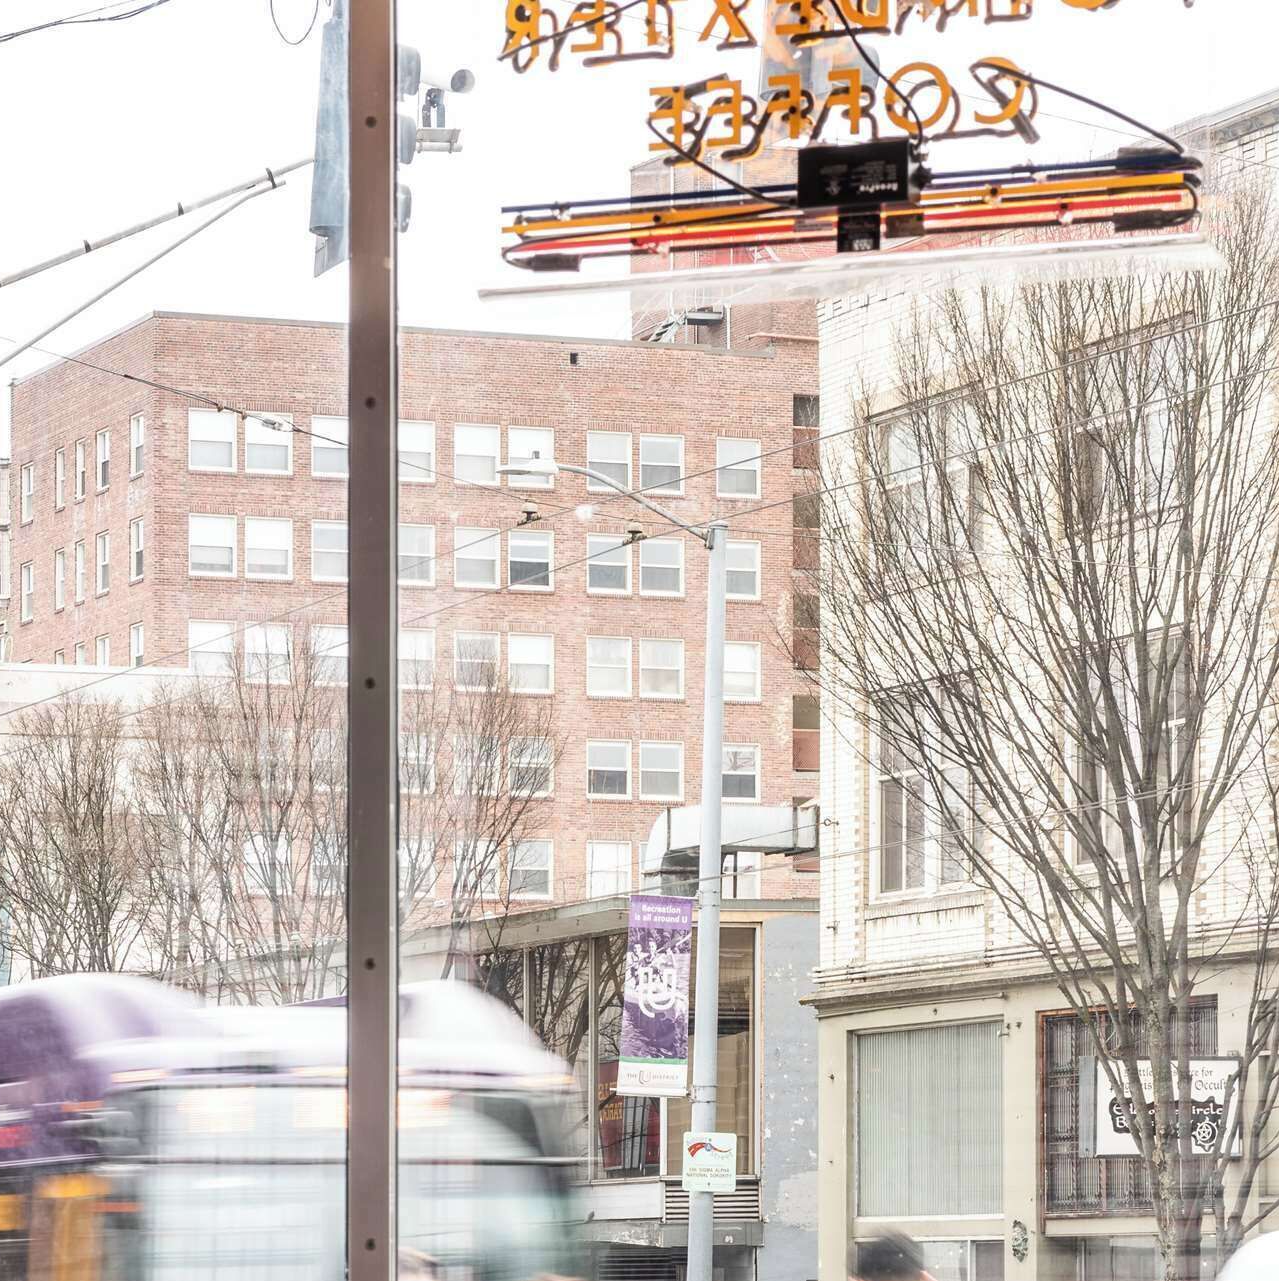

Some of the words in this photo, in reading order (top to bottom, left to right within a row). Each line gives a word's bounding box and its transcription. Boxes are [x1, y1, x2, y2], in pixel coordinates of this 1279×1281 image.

[642, 904, 680, 914] Recreation
[643, 914, 651, 922] all
[653, 915, 679, 923] around
[681, 915, 688, 923] U
[1202, 1067, 1213, 1077] for
